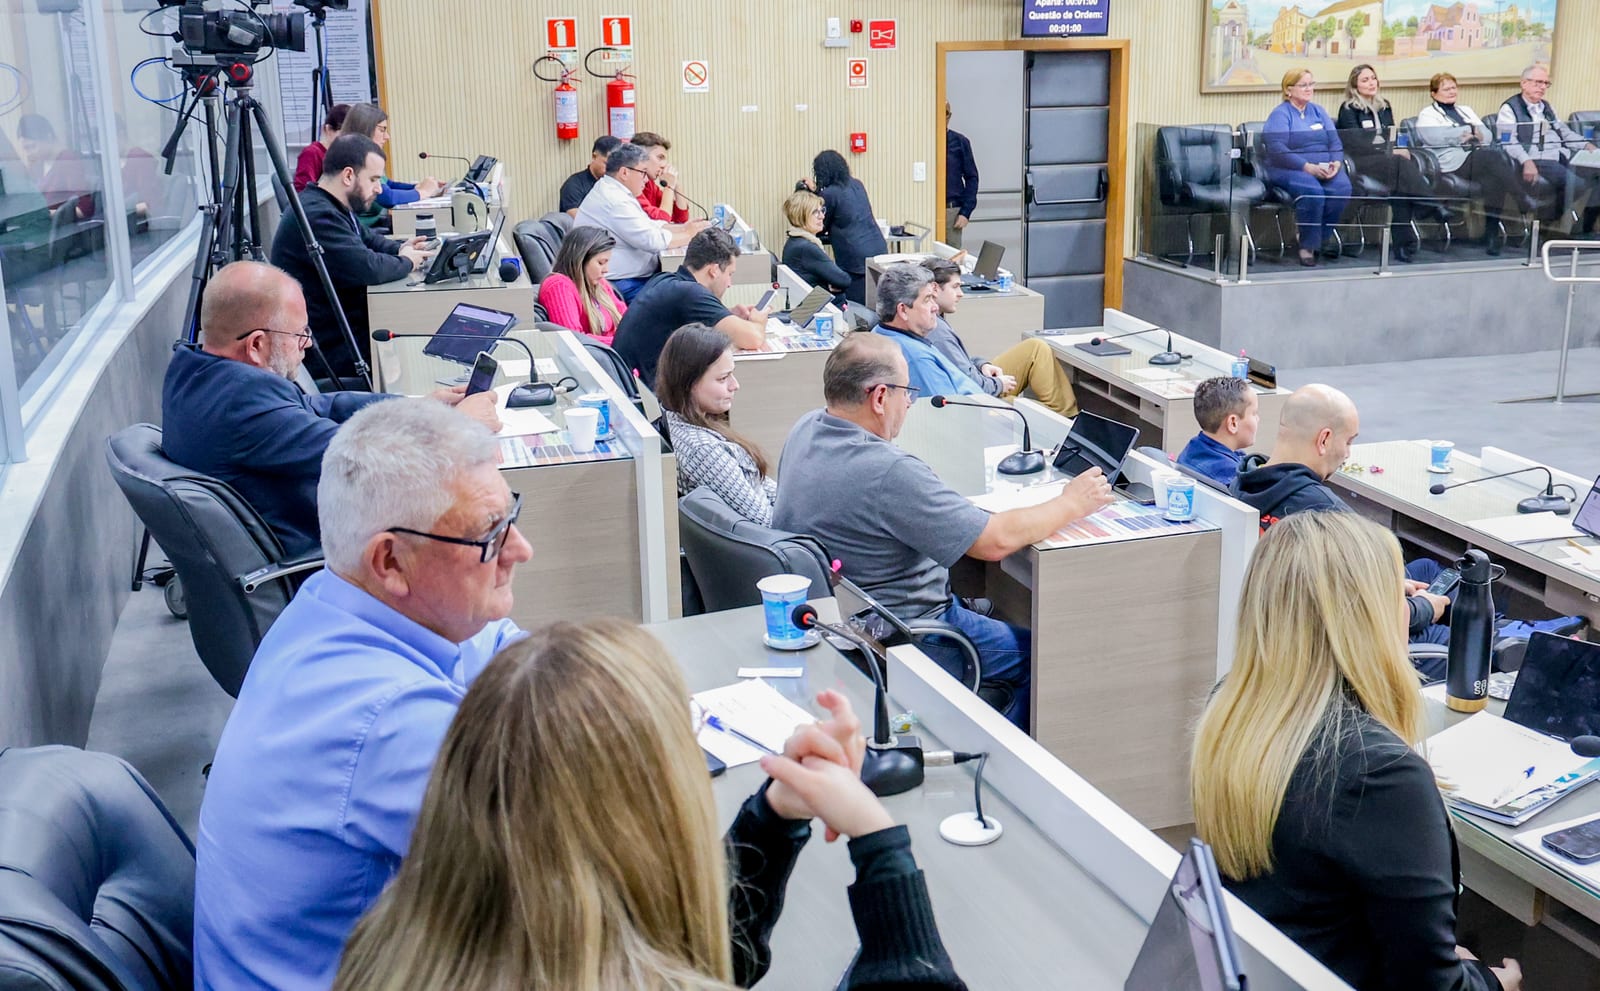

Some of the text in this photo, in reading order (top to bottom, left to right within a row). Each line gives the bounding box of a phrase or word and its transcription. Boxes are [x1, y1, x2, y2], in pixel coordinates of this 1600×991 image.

[1029, 10, 1103, 20] Questão de Ordem:
[1049, 24, 1082, 33] 00:01:00
